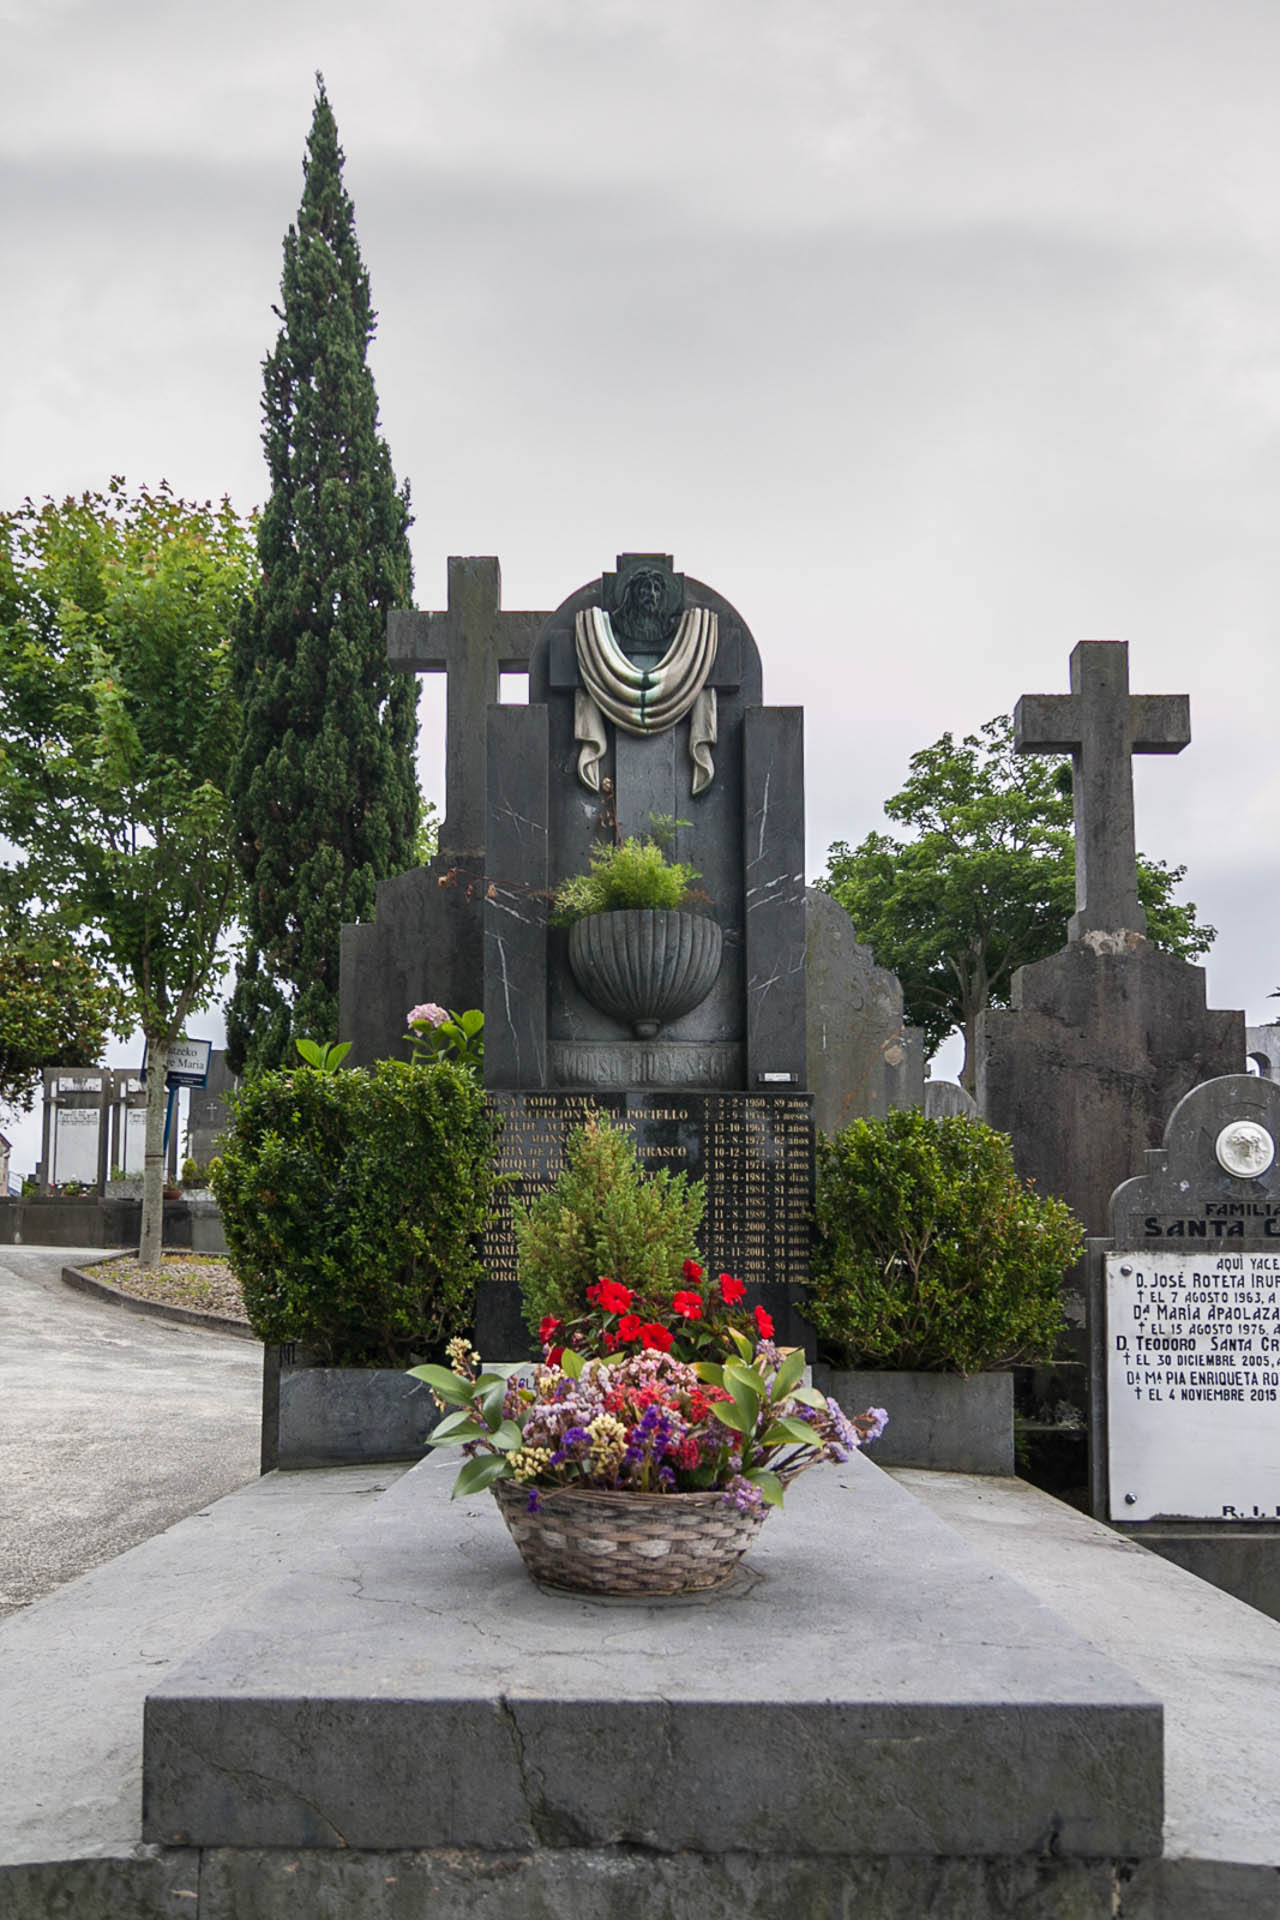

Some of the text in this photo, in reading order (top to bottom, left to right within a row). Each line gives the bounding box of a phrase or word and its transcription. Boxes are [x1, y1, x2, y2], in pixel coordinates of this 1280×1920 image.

[637, 1146, 687, 1157] RRASCO
[492, 1159, 538, 1169] NRIQUE
[1144, 1217, 1245, 1237] SANTA
[482, 1245, 518, 1256] MARI
[1250, 1258, 1280, 1270] YACE
[1150, 1271, 1187, 1289] JOSÉ
[1193, 1273, 1245, 1289] ROTETA
[1150, 1292, 1165, 1304] EL
[1171, 1292, 1178, 1304] 7
[1185, 1292, 1229, 1304] AGOSTO
[1268, 1292, 1276, 1304] A
[1157, 1304, 1201, 1321] MARÍA
[1208, 1304, 1280, 1321] APAOLAZA
[1151, 1323, 1166, 1335] EL
[1171, 1323, 1183, 1335] 15
[1189, 1323, 1233, 1335] AGOSTO
[1116, 1335, 1130, 1351] D.
[1136, 1336, 1197, 1351] TEODORO
[1210, 1336, 1252, 1351] SANTA
[1136, 1354, 1150, 1366] EL
[1157, 1354, 1172, 1366] 30
[1177, 1355, 1236, 1366] DICIEMBRE
[1190, 1371, 1259, 1386] ENRIQUETA
[1148, 1389, 1277, 1401] EL 4 NOVIEMBRE 2015
